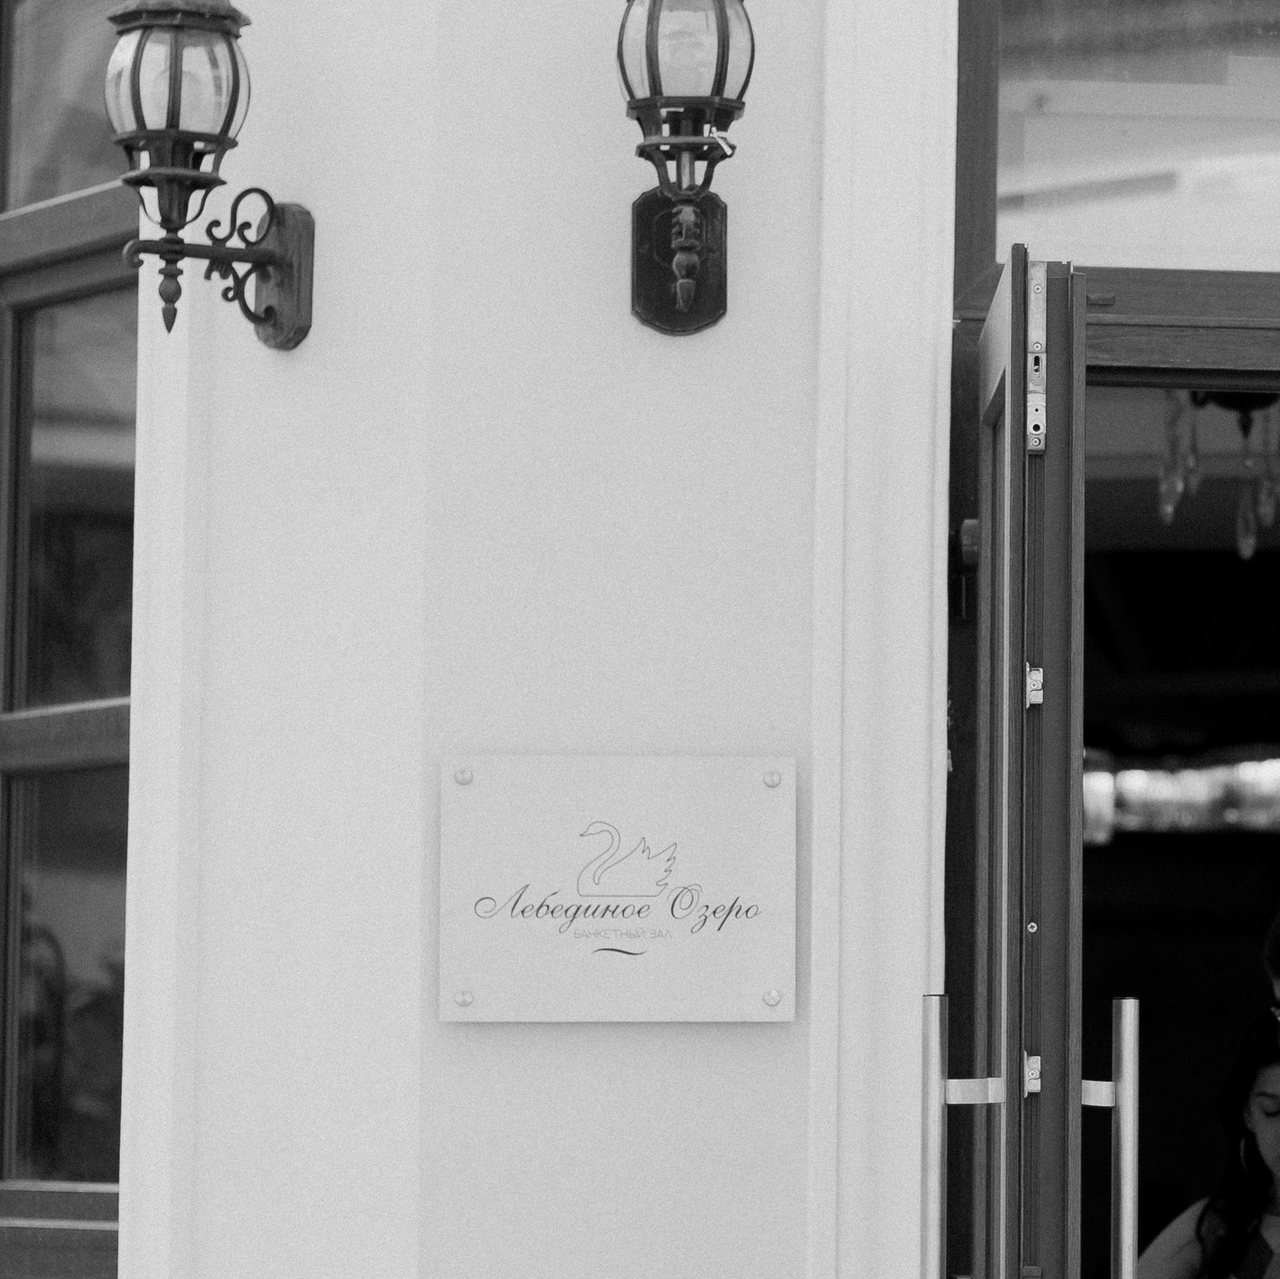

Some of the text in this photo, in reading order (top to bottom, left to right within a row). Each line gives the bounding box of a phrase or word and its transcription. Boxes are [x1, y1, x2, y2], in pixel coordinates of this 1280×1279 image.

[473, 883, 762, 934] Лебединое Озеро
[573, 927, 673, 940] БАНКЕТНЫЙ ЗАЛ
